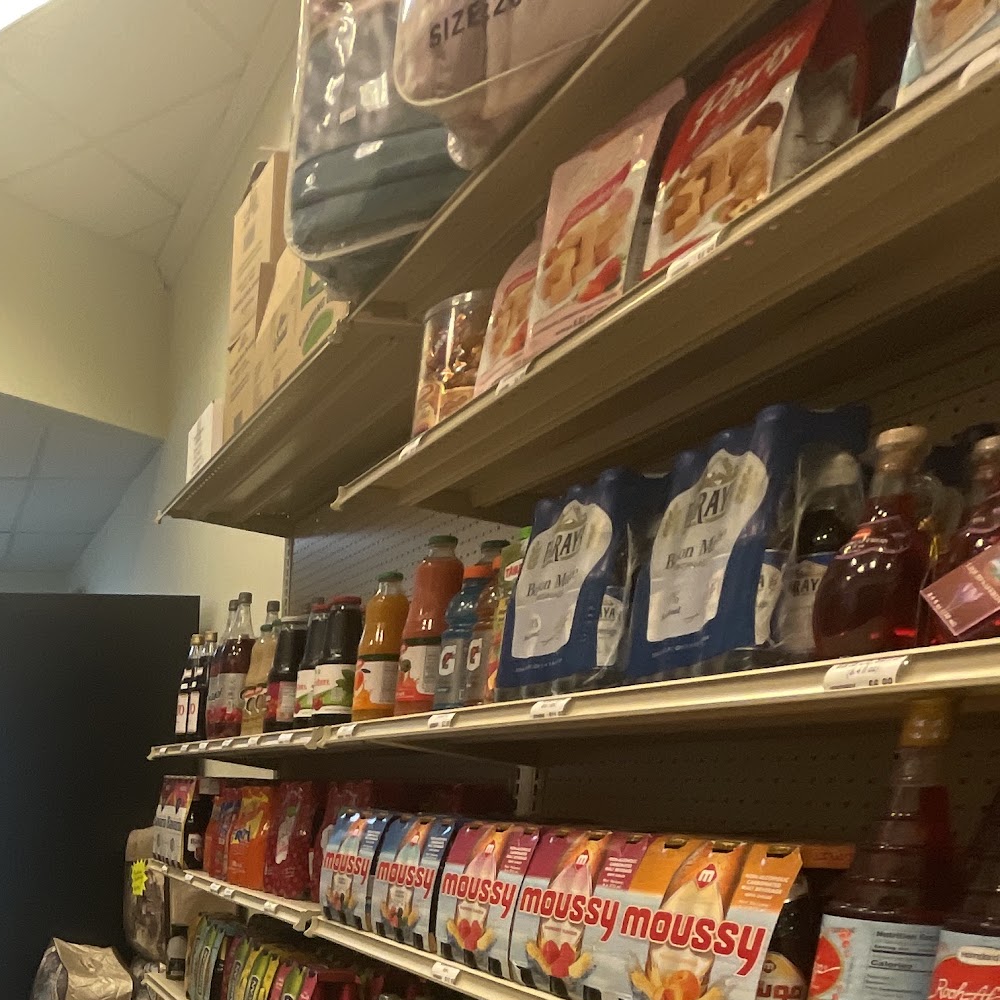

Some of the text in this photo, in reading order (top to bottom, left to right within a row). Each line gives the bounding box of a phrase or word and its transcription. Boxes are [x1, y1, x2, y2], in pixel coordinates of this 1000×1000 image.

[322, 851, 371, 886] moussy
[376, 861, 437, 900] moussy
[441, 871, 517, 920] moussy
[518, 884, 621, 943] moussy
[619, 904, 767, 977] moussy
